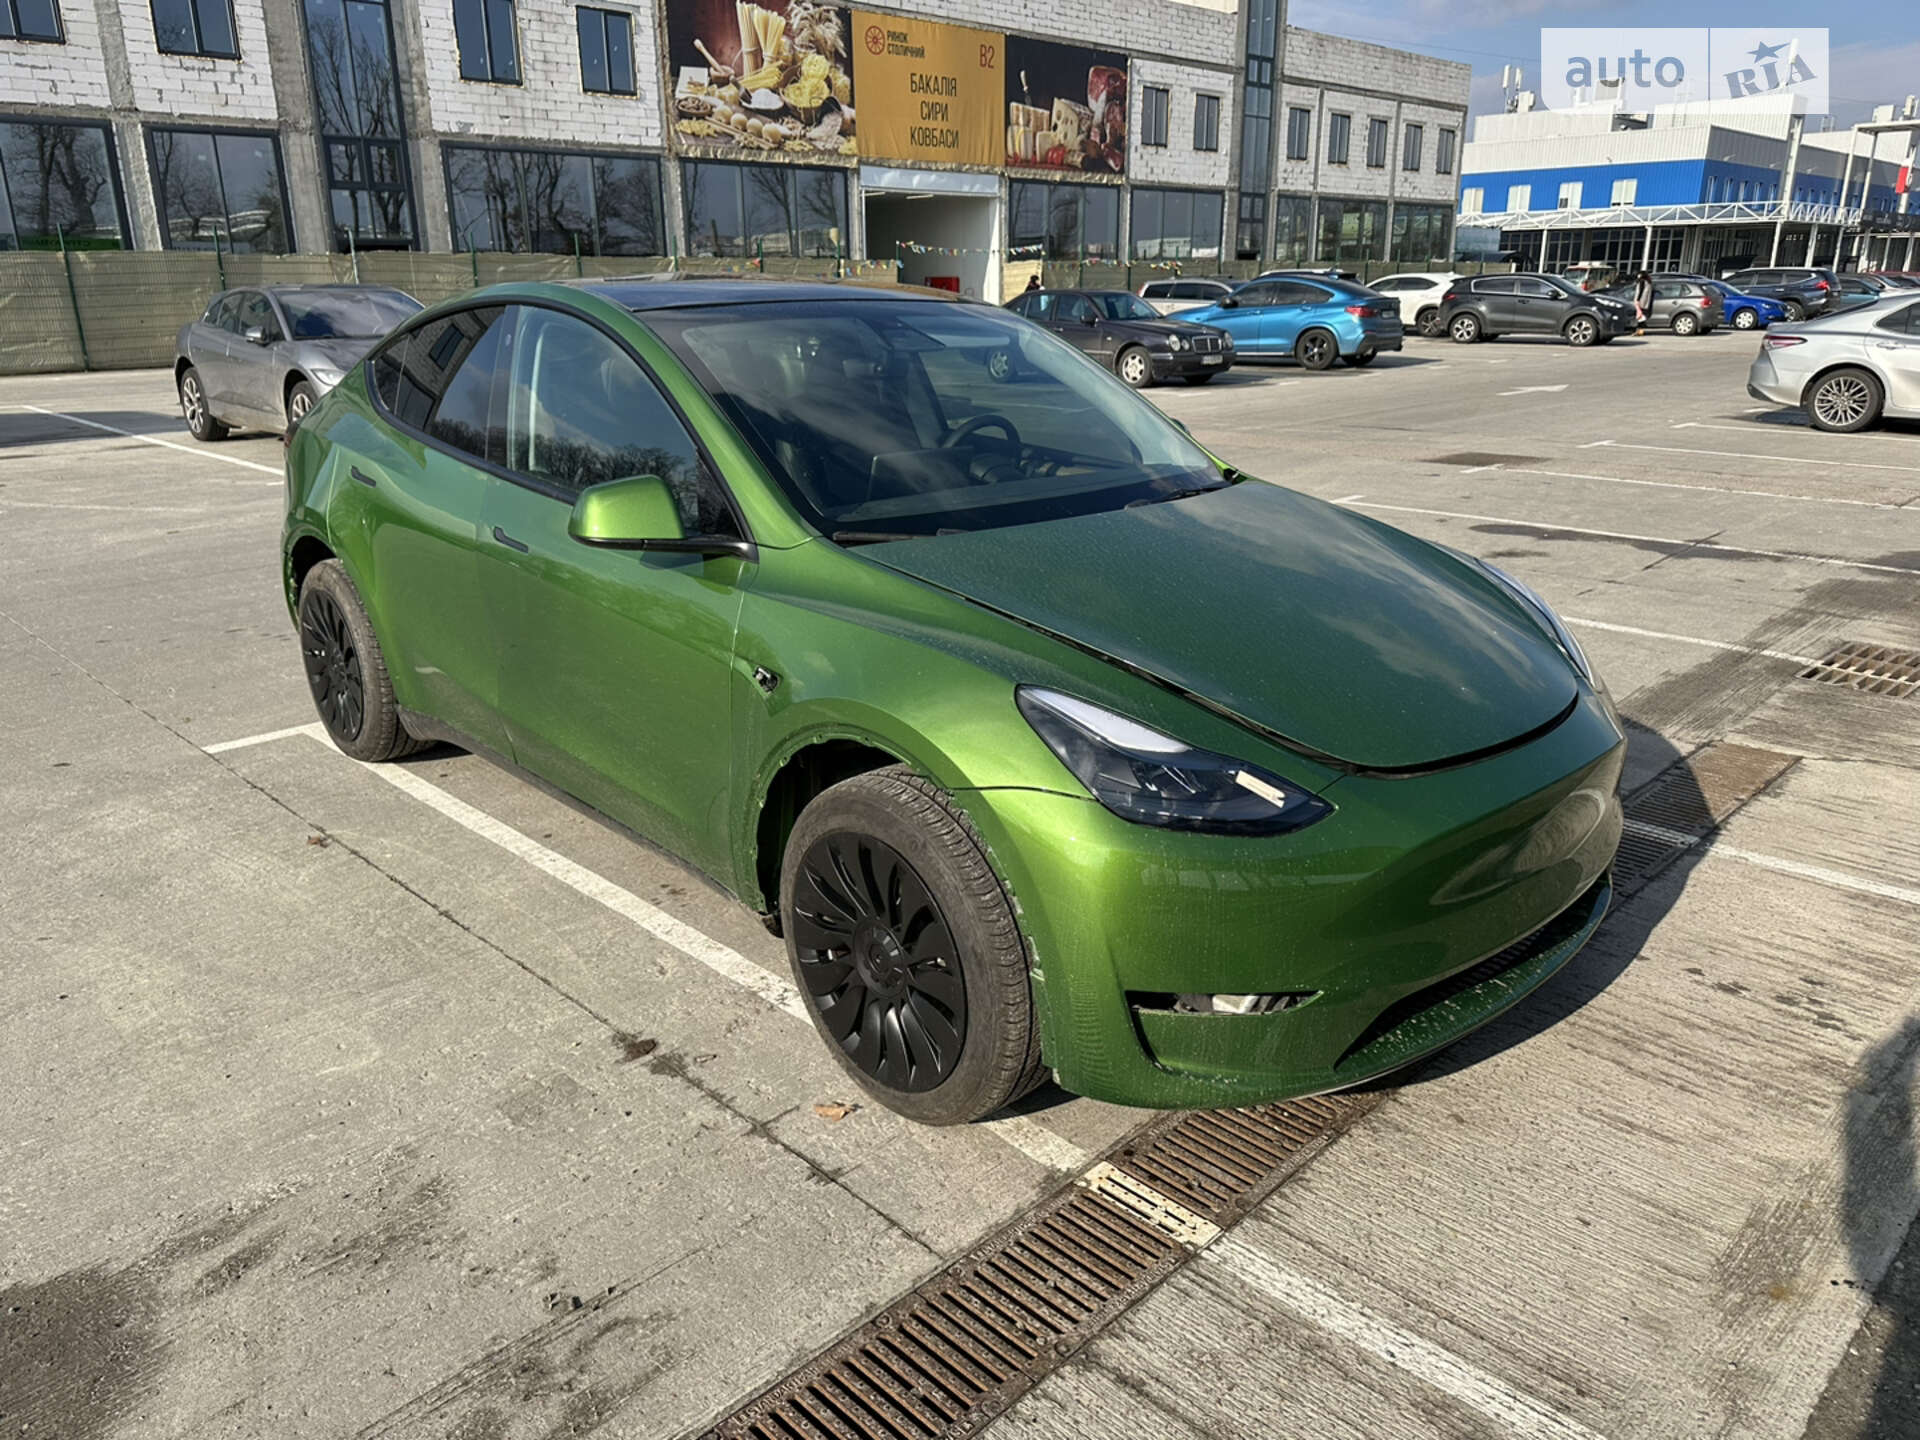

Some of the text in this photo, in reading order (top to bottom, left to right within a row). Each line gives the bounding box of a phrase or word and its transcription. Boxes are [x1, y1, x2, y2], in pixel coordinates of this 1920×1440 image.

[910, 73, 957, 97] БАКАЛІЯ
[920, 100, 949, 122] СИРИ
[910, 126, 959, 149] КОВБАСИ
